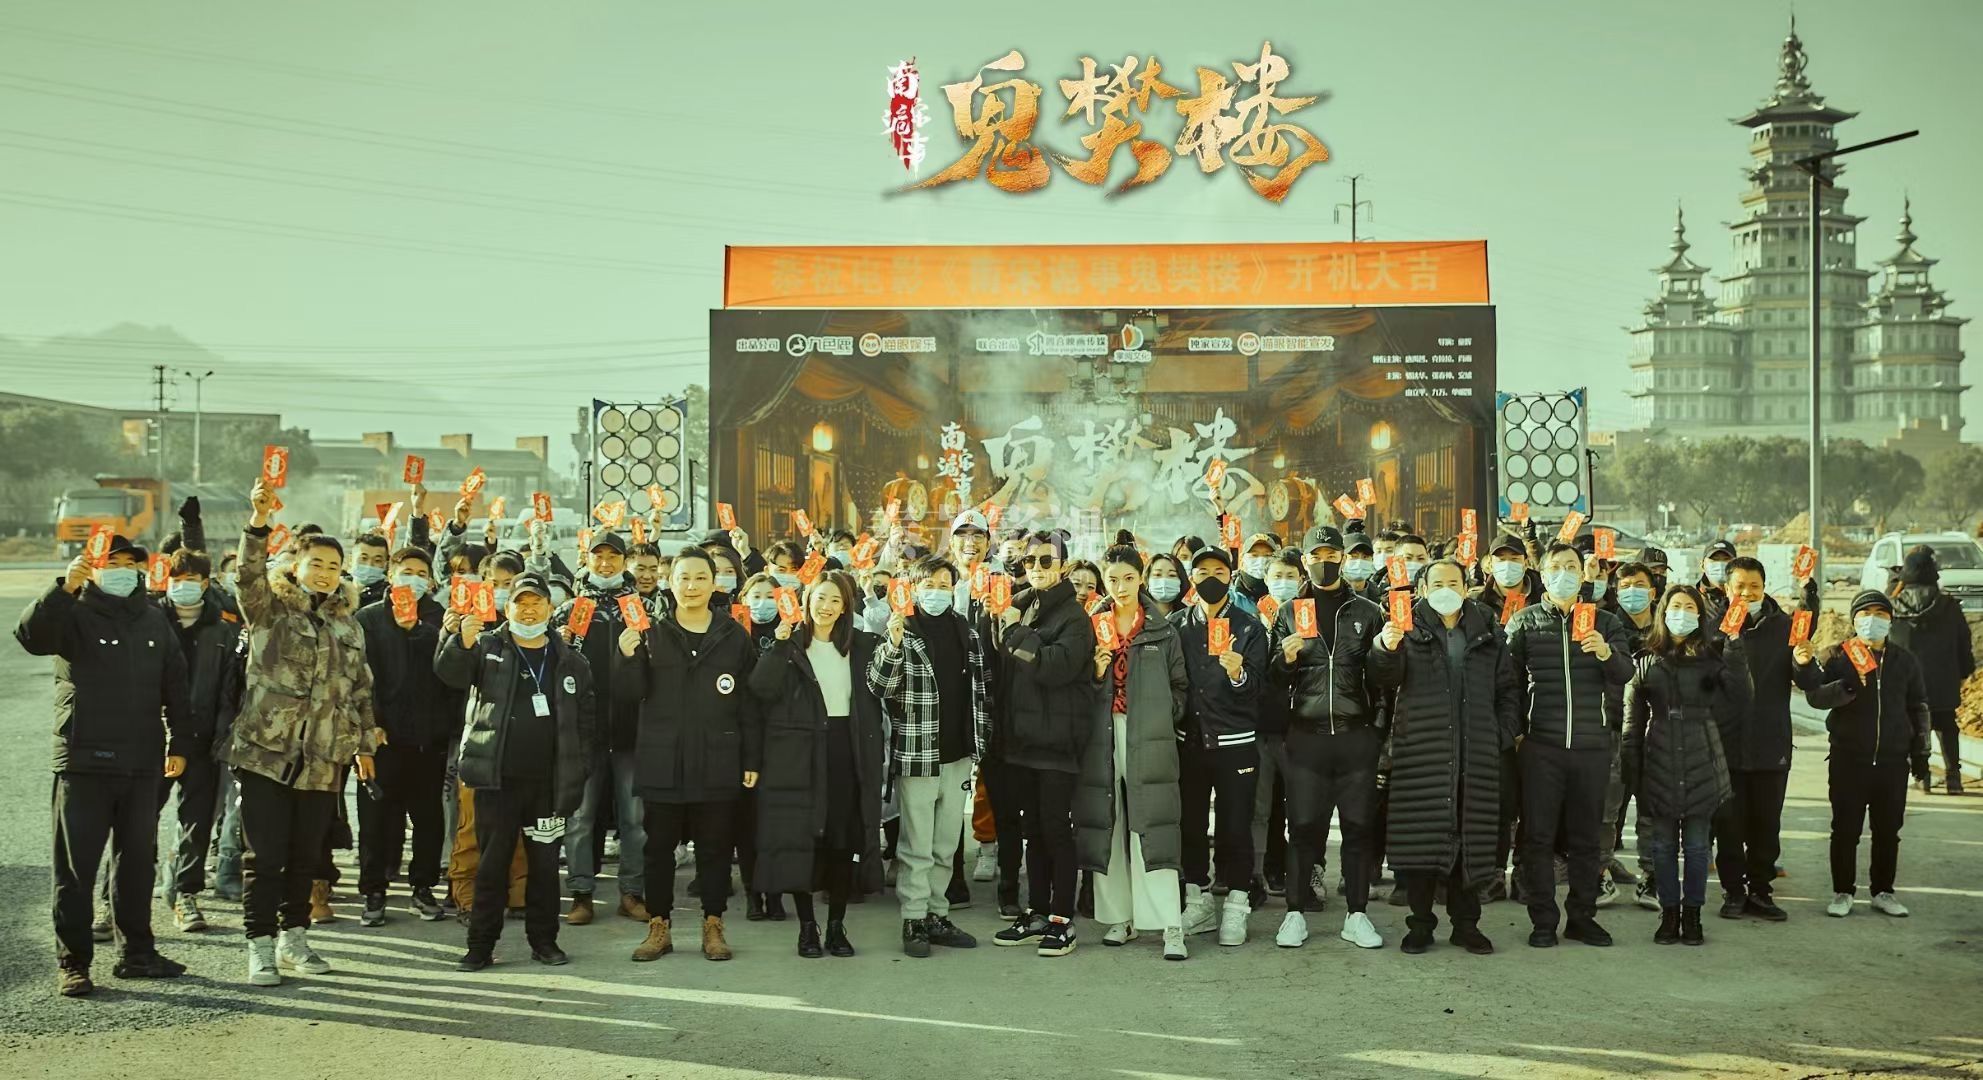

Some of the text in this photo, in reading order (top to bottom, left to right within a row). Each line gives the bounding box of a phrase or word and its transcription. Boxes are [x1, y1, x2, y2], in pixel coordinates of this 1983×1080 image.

[736, 338, 780, 352] 出品公司
[807, 336, 853, 355] 九色鹿
[882, 336, 937, 353] 猫眼娱乐
[976, 338, 1020, 352] 联合出品
